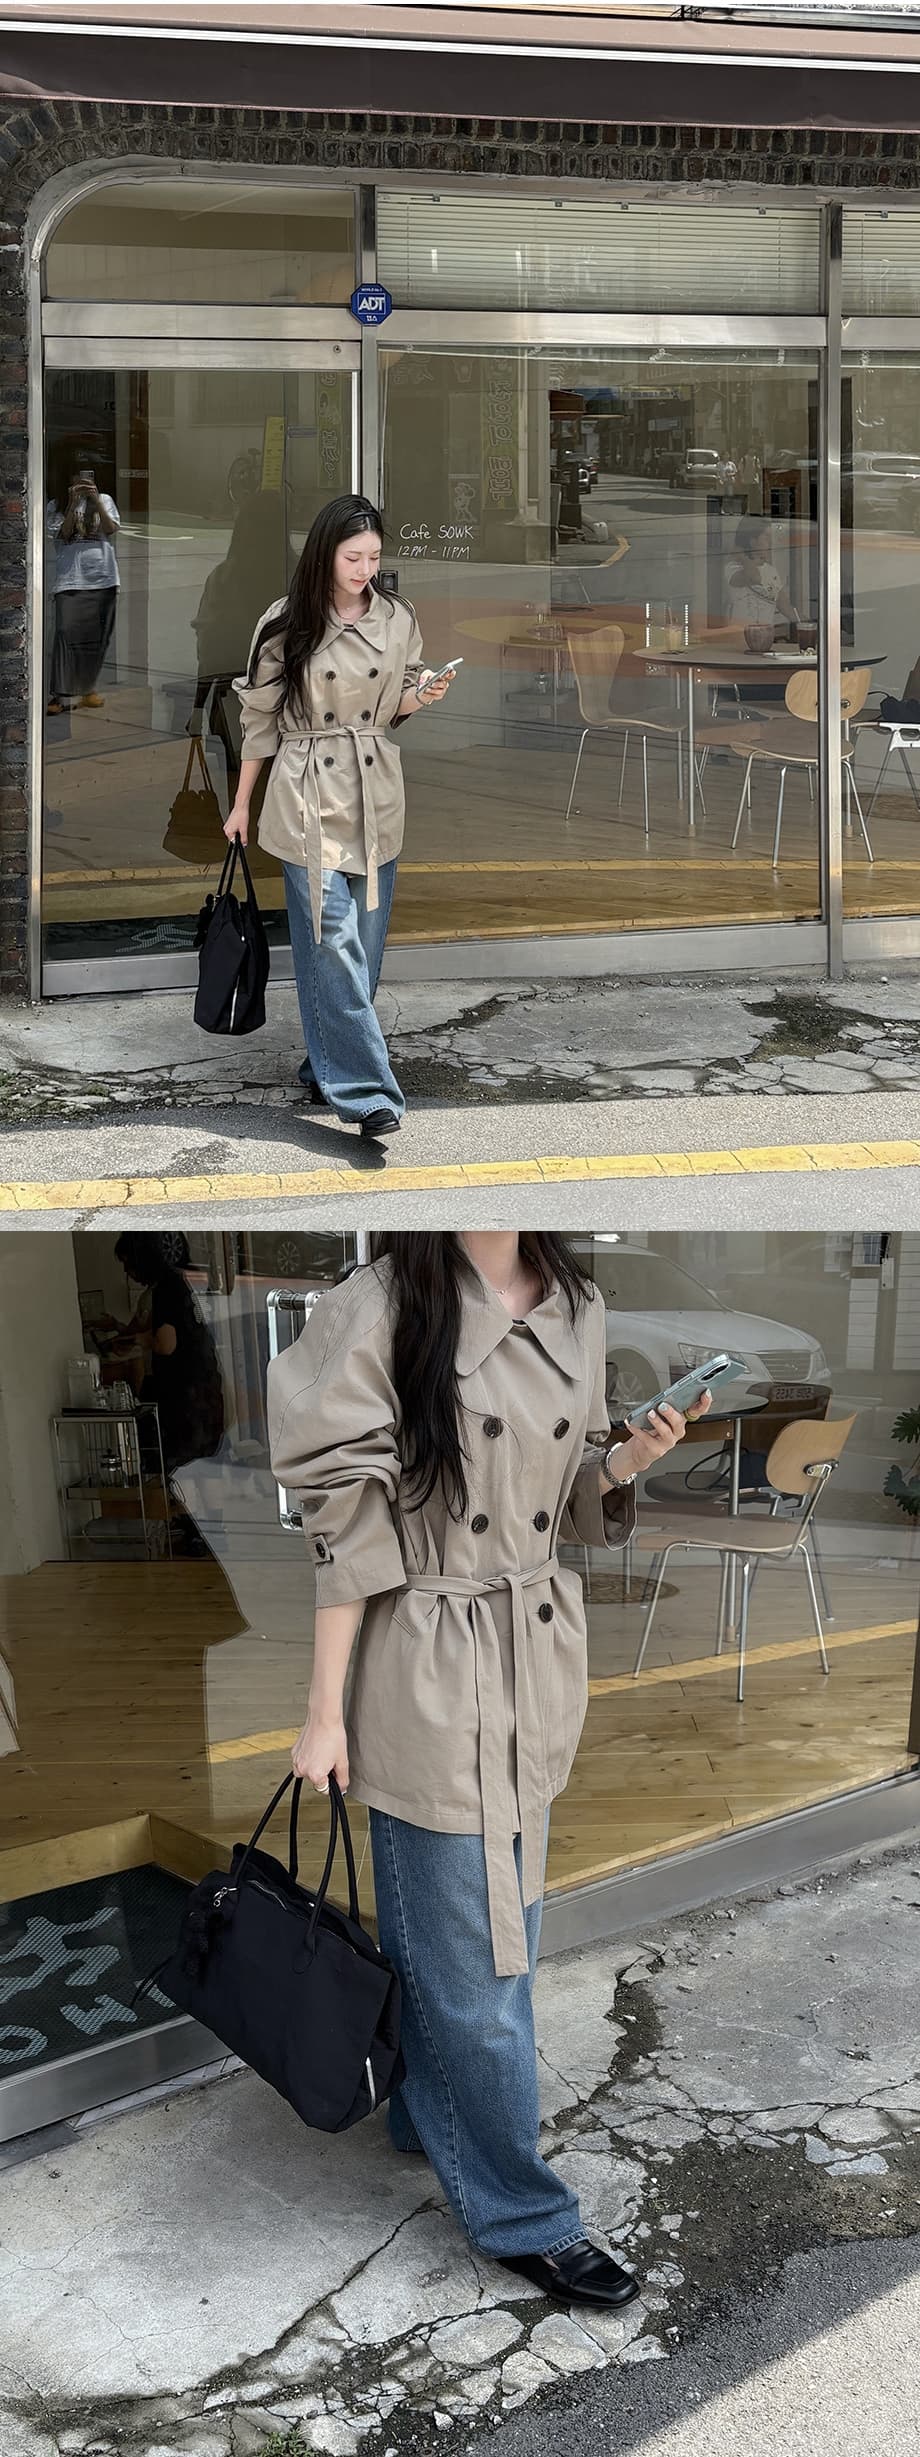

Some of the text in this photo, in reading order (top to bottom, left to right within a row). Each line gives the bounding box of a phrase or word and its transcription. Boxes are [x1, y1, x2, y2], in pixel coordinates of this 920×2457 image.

[358, 297, 385, 311] ADT
[399, 523, 474, 540] Cafe SOWK
[397, 544, 428, 557] 12PM
[442, 545, 470, 560] 11PM
